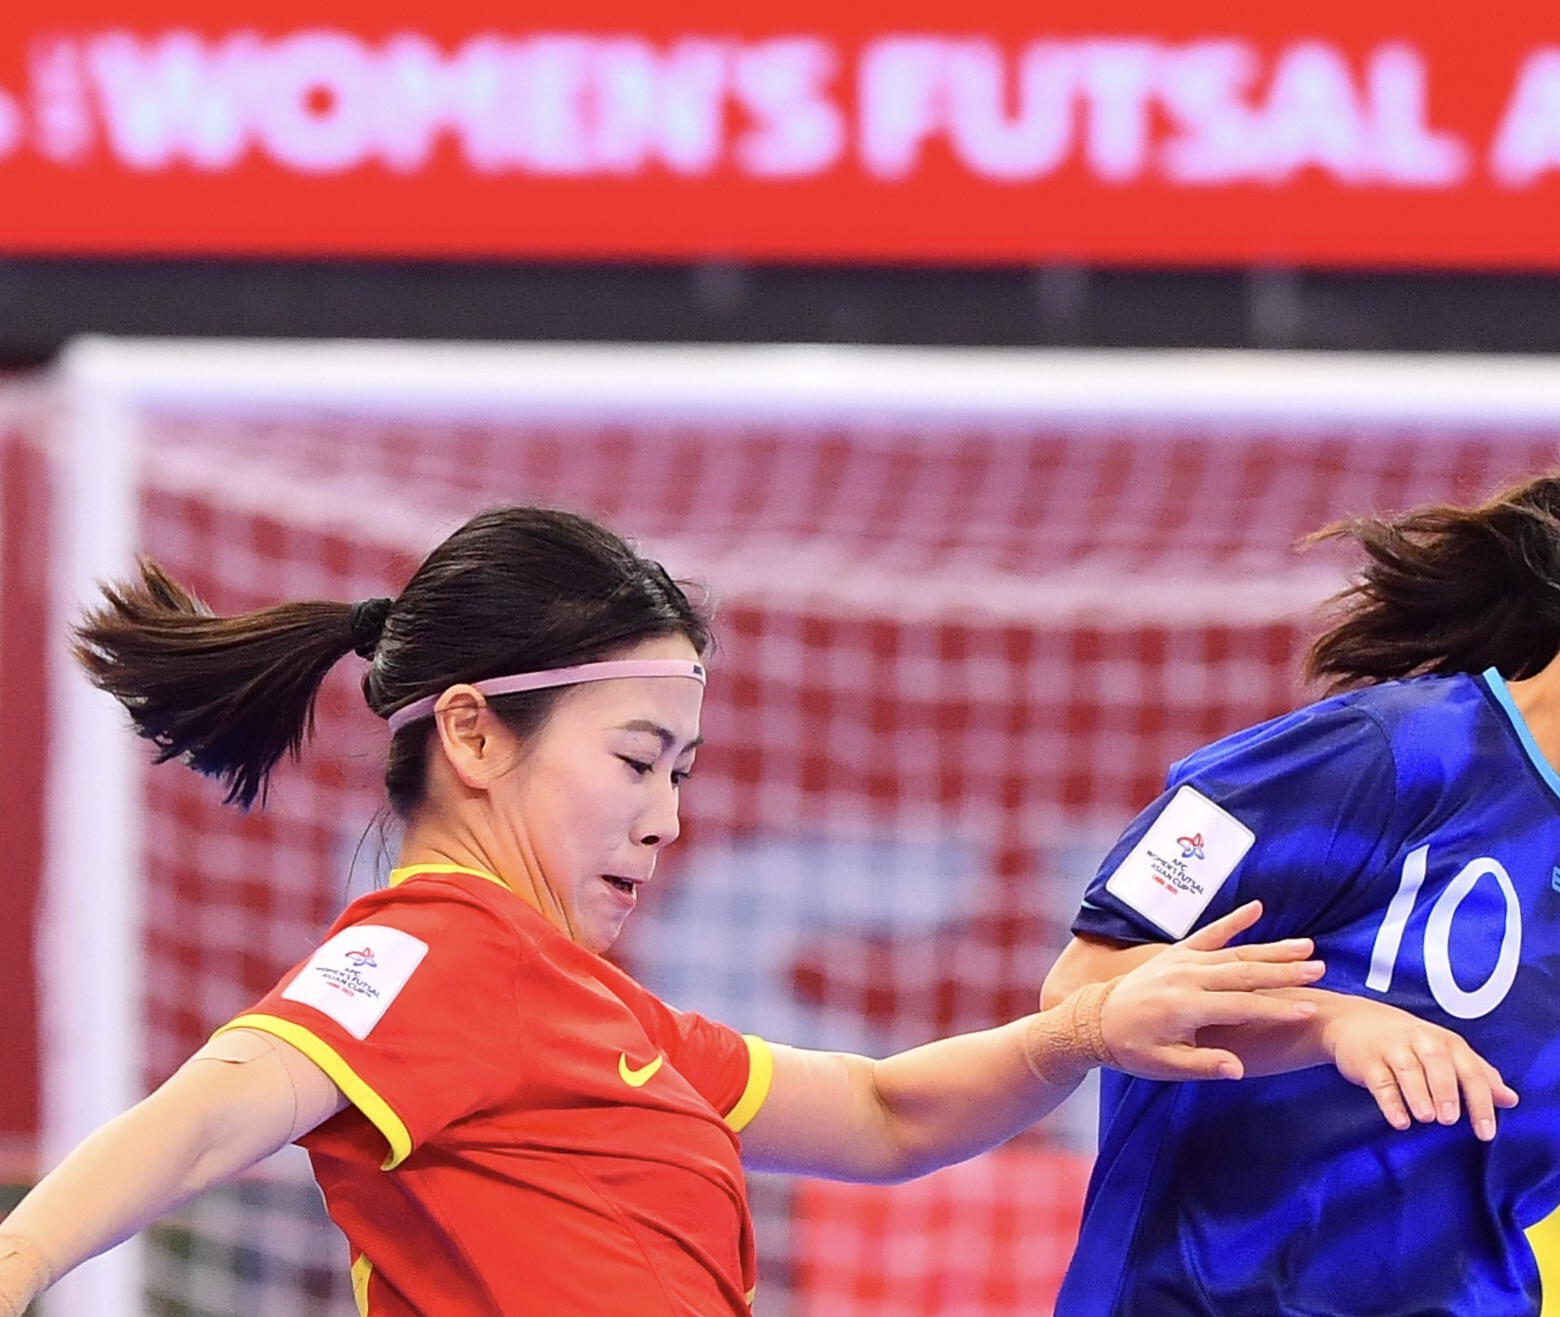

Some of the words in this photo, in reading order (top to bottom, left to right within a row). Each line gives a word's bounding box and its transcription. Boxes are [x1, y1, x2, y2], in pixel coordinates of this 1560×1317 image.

[91, 32, 847, 178] WOMEN'S
[857, 36, 1469, 187] FUTSAL
[1365, 843, 1522, 1020] 10
